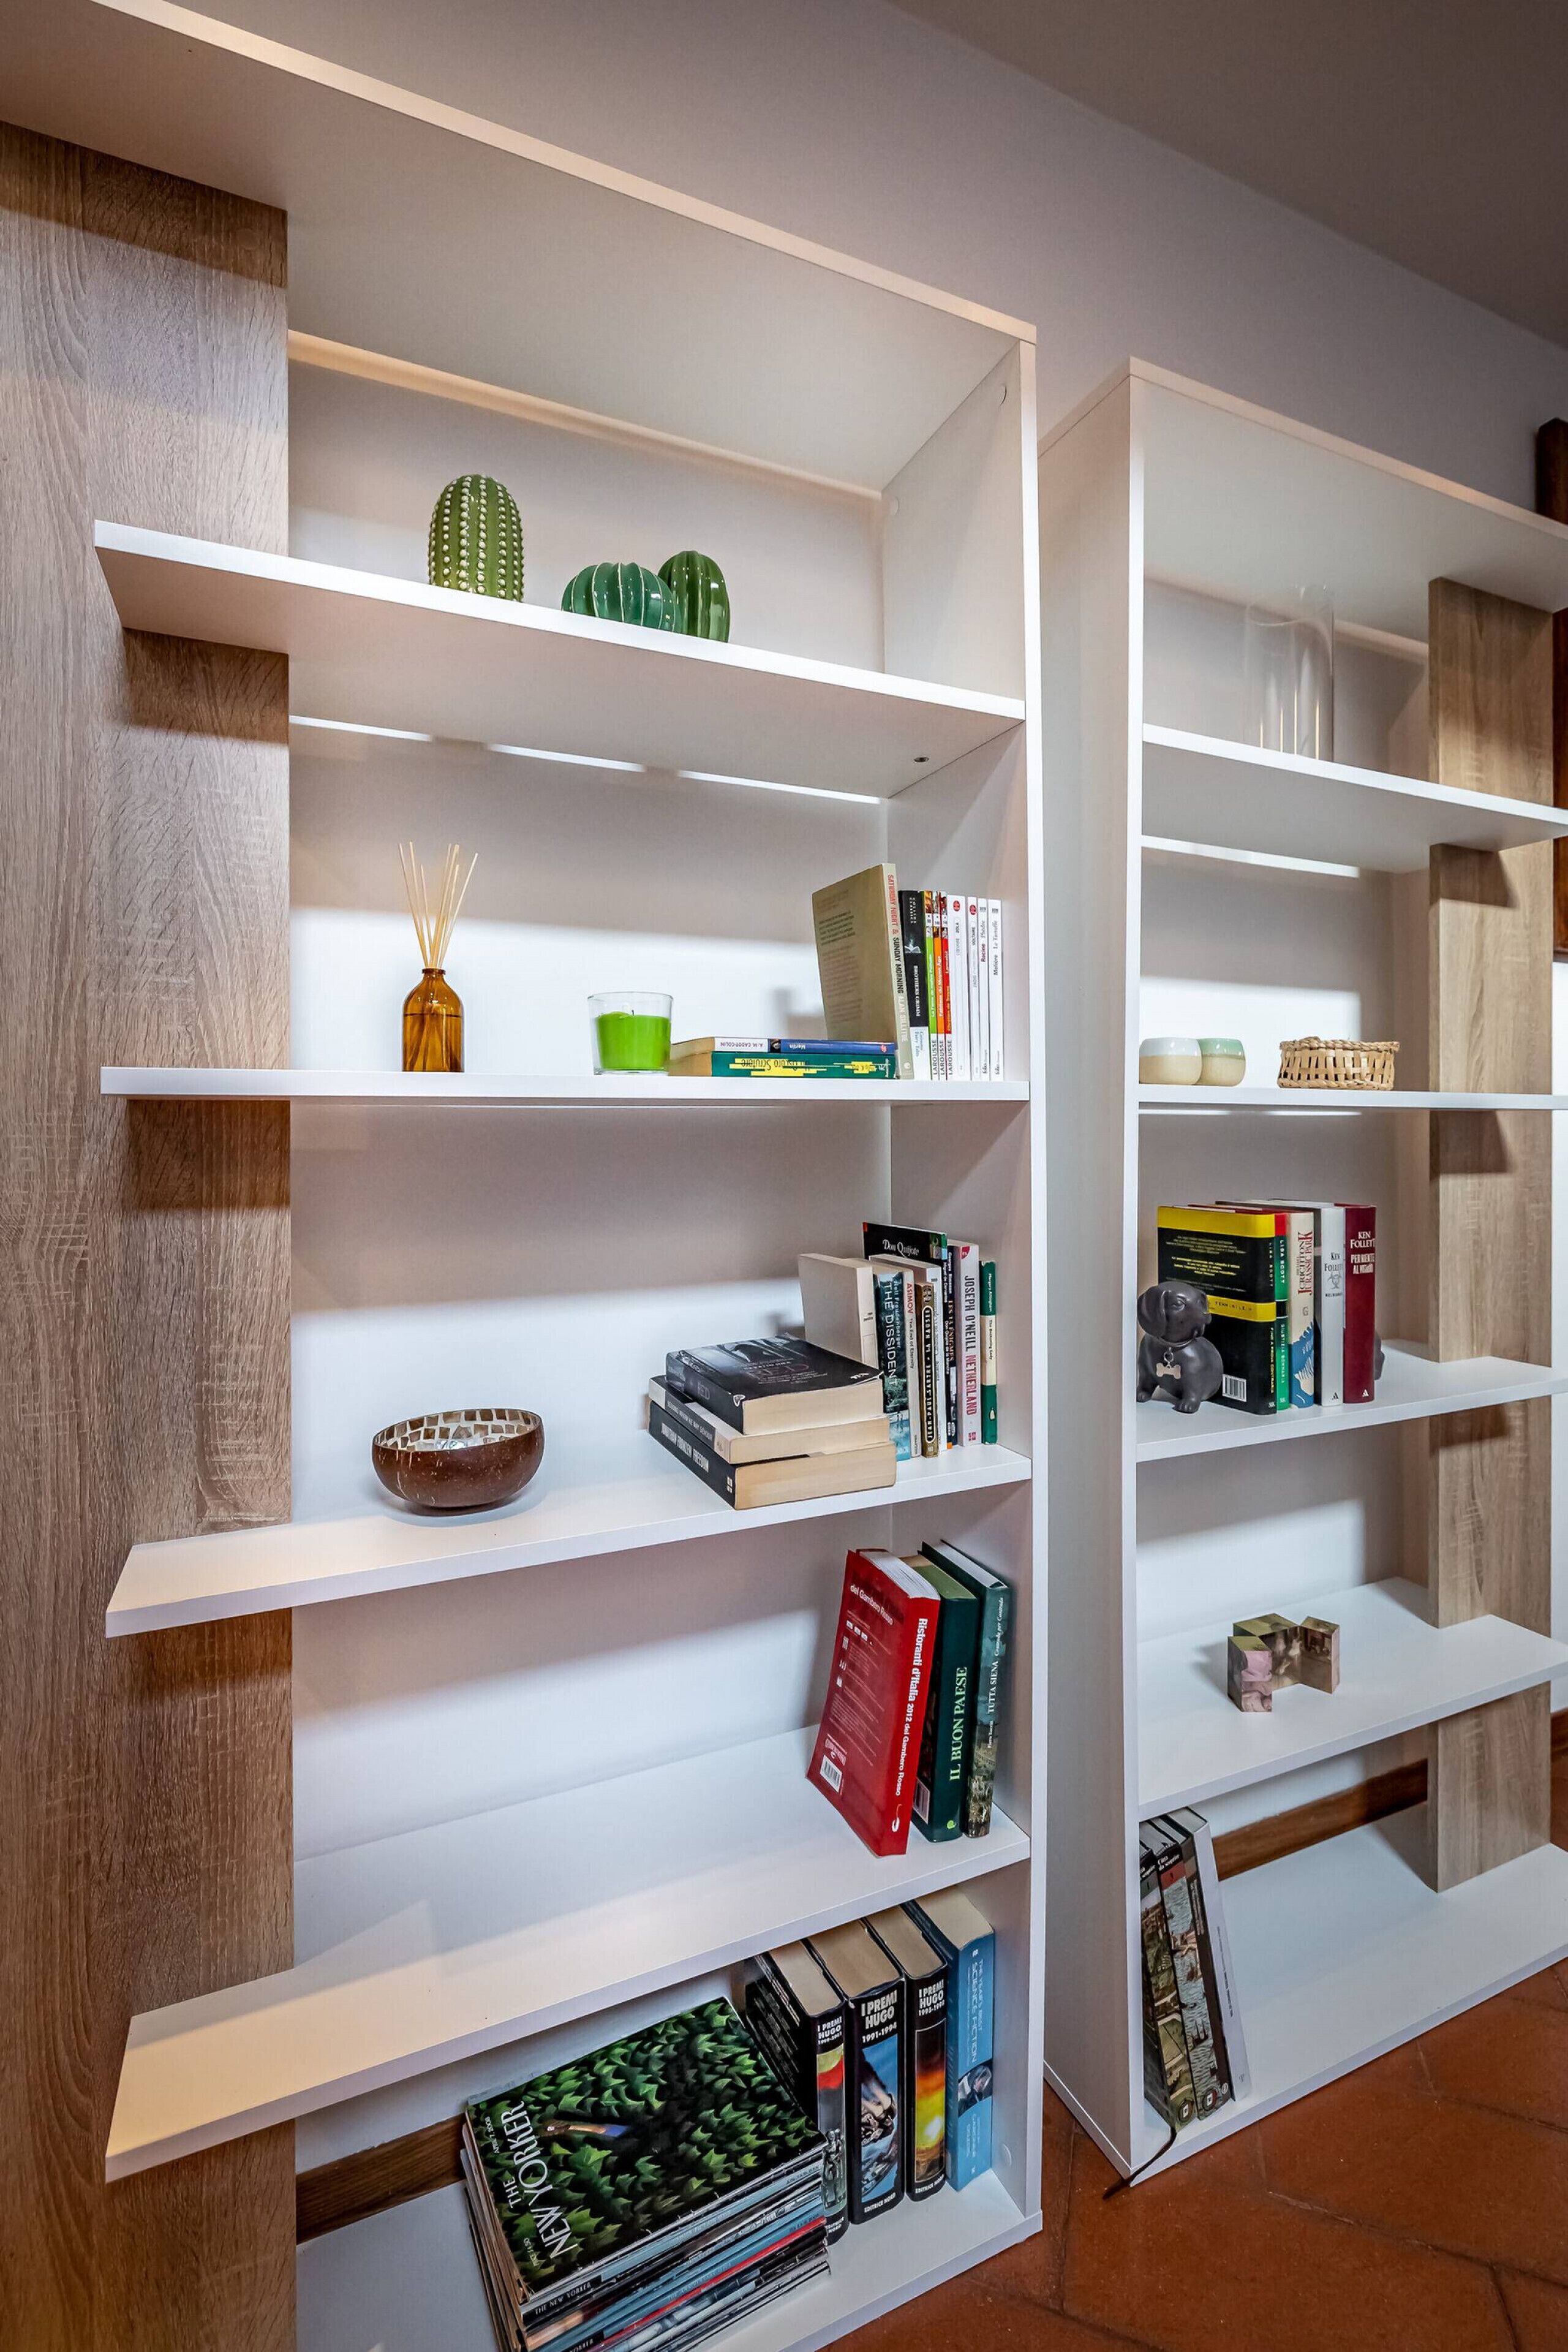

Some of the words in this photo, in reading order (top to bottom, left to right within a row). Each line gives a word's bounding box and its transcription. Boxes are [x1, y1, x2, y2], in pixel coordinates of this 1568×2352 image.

[895, 964, 904, 994] MORNING
[883, 1239, 896, 1251] Don
[1358, 1231, 1371, 1239] KEN
[884, 1282, 894, 1310] THE
[964, 1276, 975, 1312] JOSEPH
[965, 1315, 976, 1352] O'NEILL
[885, 1314, 897, 1385] DISSIDENT
[925, 1344, 931, 1353] LA
[965, 1355, 977, 1415] NETHERLAND
[913, 1617, 929, 1666] Ristoranti
[908, 1668, 921, 1701] d'Italia
[990, 1660, 999, 1685] SIENA
[954, 1666, 968, 1715] PAESE
[987, 1685, 998, 1714] TUTTA
[905, 1703, 914, 1722] 2012
[899, 1736, 910, 1771] Gambero
[951, 1718, 964, 1762] BUON
[895, 1772, 905, 1796] Rosso
[949, 1764, 960, 1782] IL
[919, 1989, 922, 1998] I
[923, 1979, 944, 1997] PREMI
[919, 1989, 944, 2009] HUGO
[861, 2003, 865, 2017] I
[867, 1990, 897, 2015] PREMI
[822, 2016, 842, 2031] PREMI
[865, 2005, 895, 2030] HUGO
[818, 2024, 842, 2040] HUGO
[862, 2021, 897, 2043] 1991-1994
[501, 2101, 553, 2206] YORKER
[503, 2176, 521, 2209] THE
[915, 2183, 933, 2194] EDITRICE
[864, 2198, 884, 2214] EDITRICE
[884, 2192, 896, 2205] NORD
[530, 2206, 578, 2259] NEW
[535, 2304, 548, 2316] THE
[549, 2296, 564, 2309] NEW
[565, 2281, 590, 2301] YORKER
